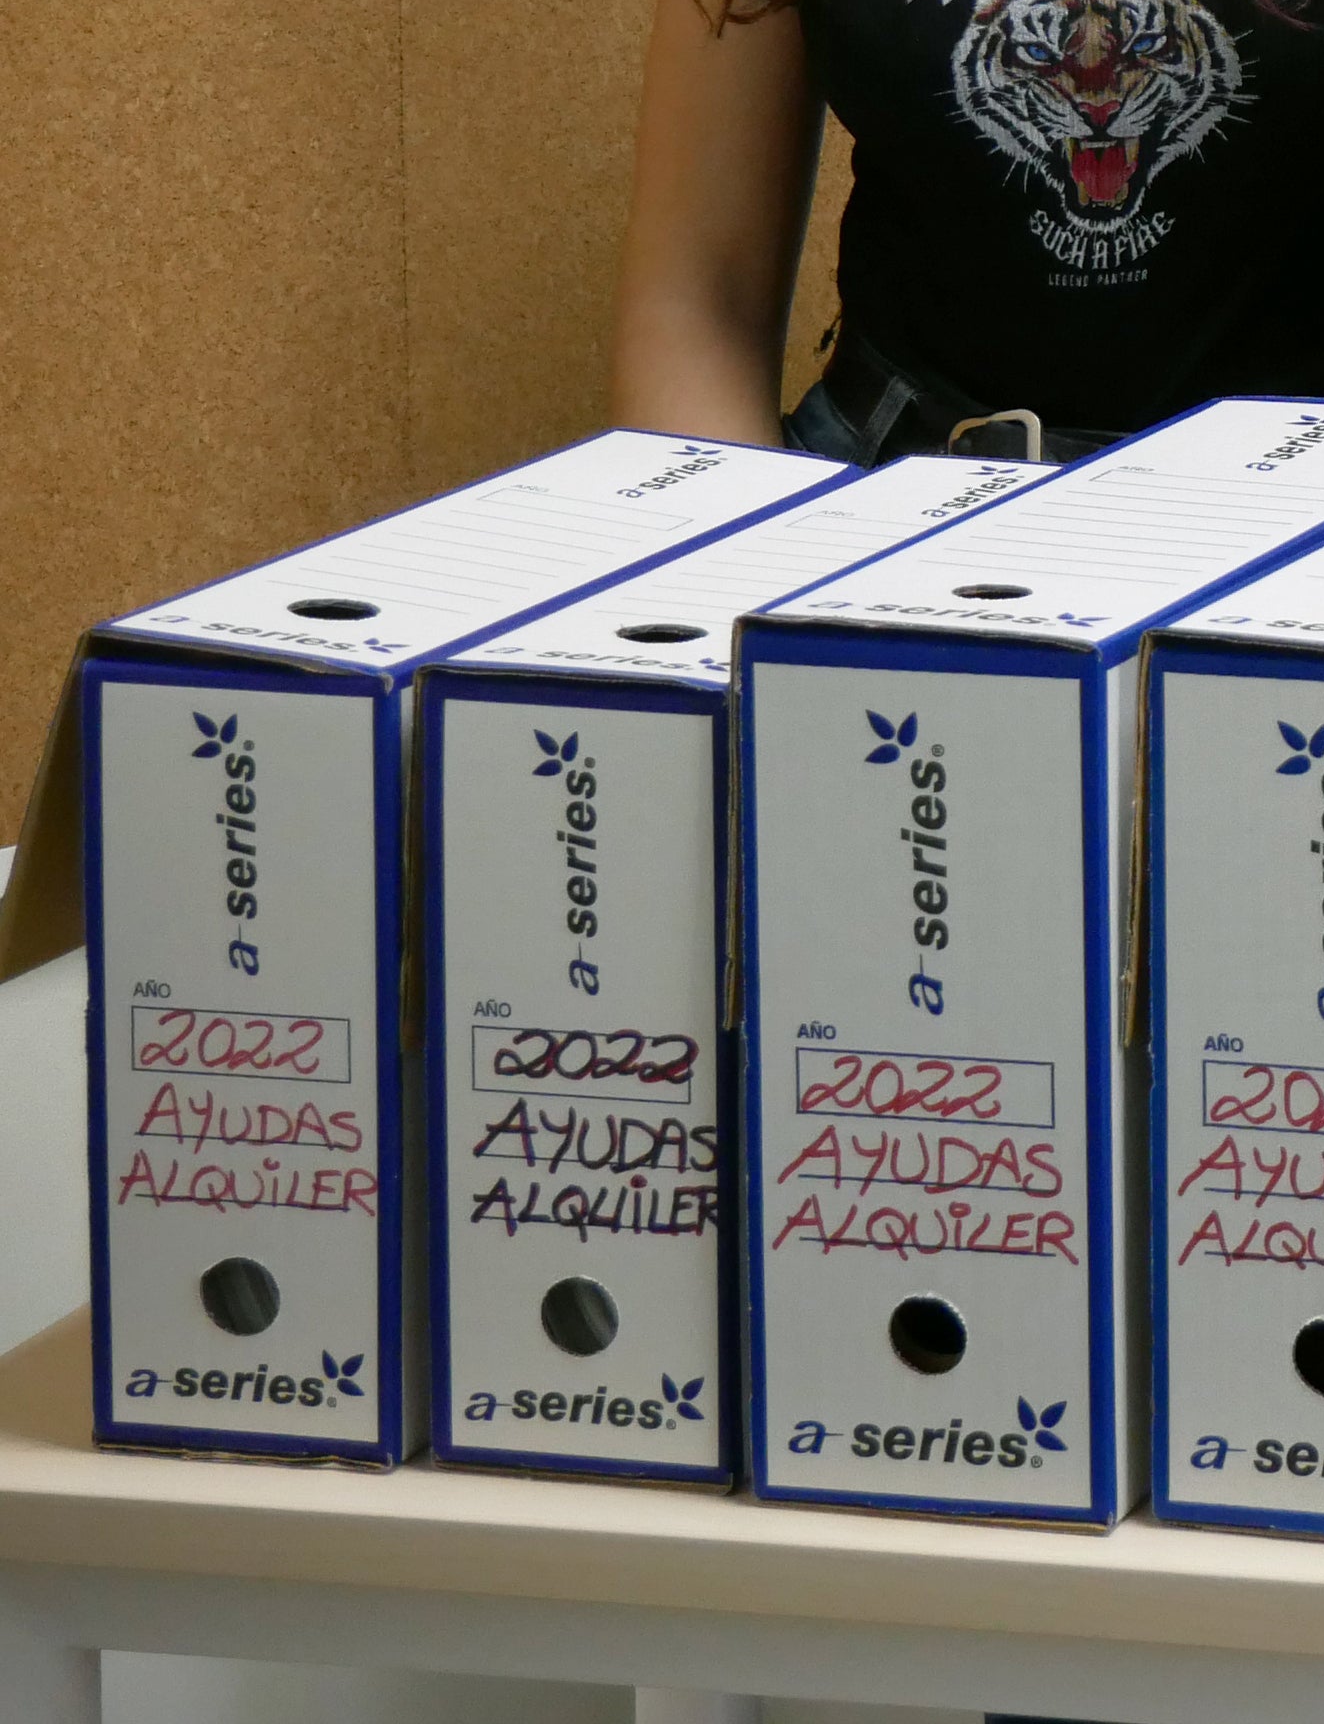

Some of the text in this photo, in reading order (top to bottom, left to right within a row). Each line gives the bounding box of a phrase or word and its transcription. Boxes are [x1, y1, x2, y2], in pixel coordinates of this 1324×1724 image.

[1028, 209, 1176, 269] SUCH A FIRE
[133, 979, 171, 998] AÑO
[473, 998, 512, 1018] AÑO
[140, 1009, 323, 1074] 2022
[493, 1028, 699, 1084] 2022
[796, 1021, 837, 1040] AÑO
[1203, 1033, 1244, 1053] AÑO
[800, 1055, 1002, 1119] 2022
[138, 1082, 362, 1155] AYUDAS
[472, 1097, 718, 1174] AYUDAS
[777, 1124, 1062, 1199] AYUDAS
